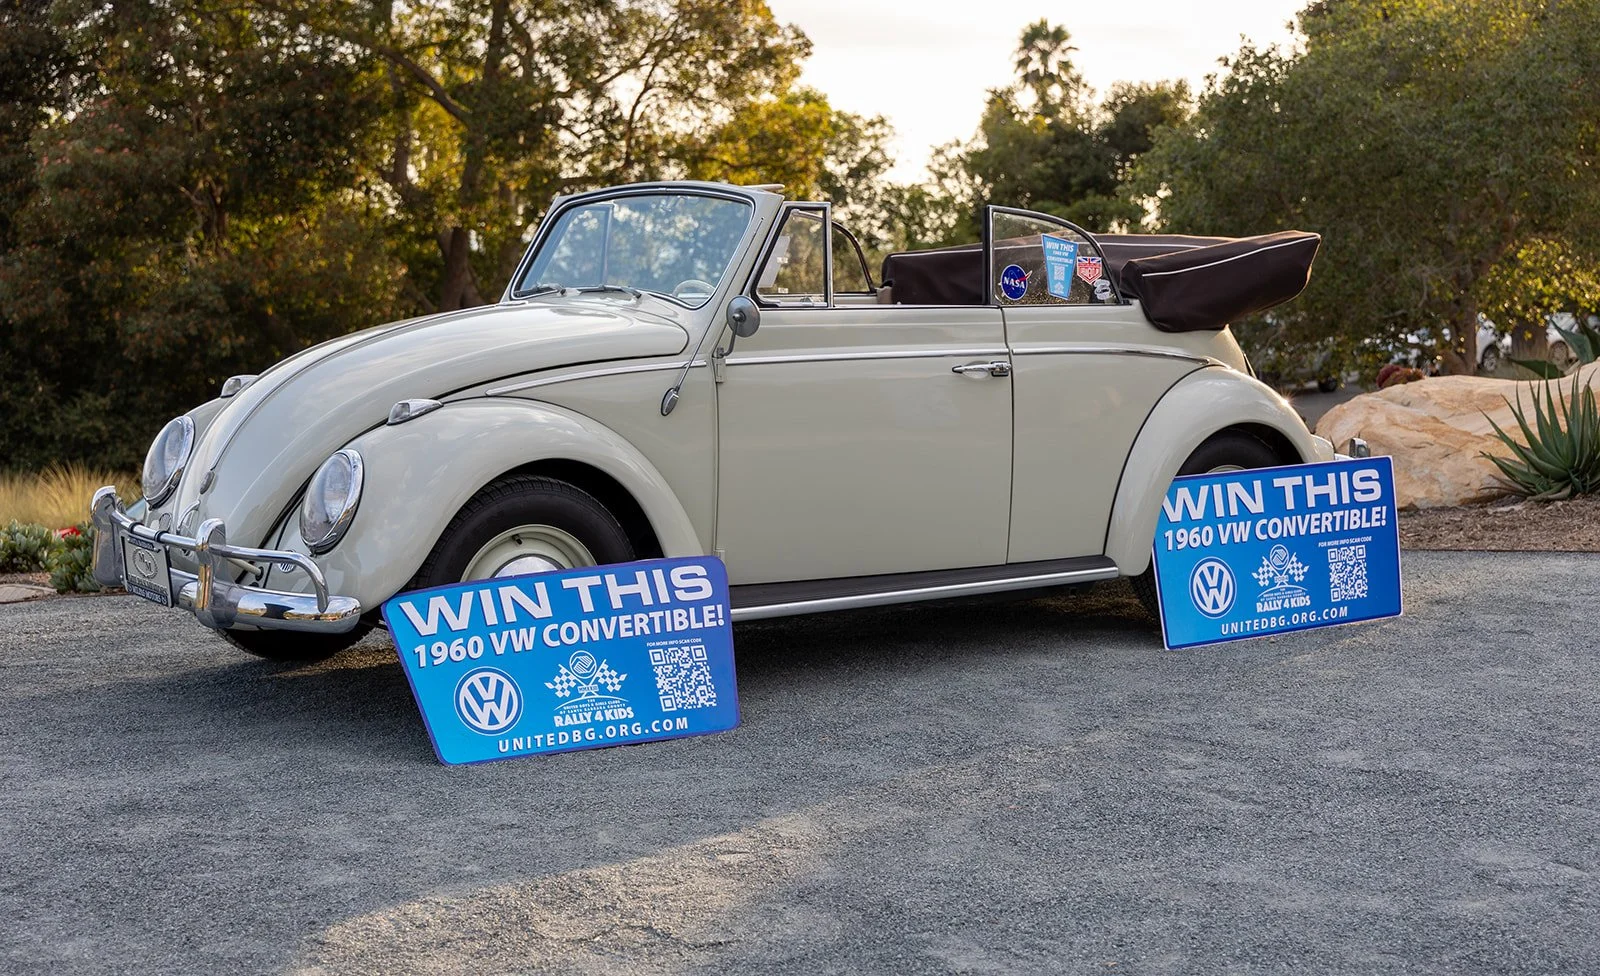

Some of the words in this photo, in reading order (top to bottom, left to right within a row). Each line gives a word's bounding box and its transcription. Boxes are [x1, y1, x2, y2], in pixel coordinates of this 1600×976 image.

[1046, 241, 1059, 250] WIN
[1060, 243, 1074, 253] THIS
[1003, 276, 1026, 289] NASA
[1161, 480, 1265, 523] WIN
[1272, 468, 1382, 510] THIS
[1164, 525, 1213, 551] 1960
[1217, 520, 1252, 545] VW
[1255, 506, 1388, 541] CONVERTIBLE!
[399, 580, 553, 637] WIN
[561, 565, 714, 613] THIS
[1192, 560, 1234, 615] VW
[1256, 599, 1283, 613] RALLY
[1283, 598, 1290, 609] 4
[1290, 595, 1311, 608] KIDS
[414, 635, 484, 668] 1960
[490, 626, 537, 655] VW
[543, 605, 725, 647] CONVERTIBLE!
[1221, 606, 1348, 635] UNITEDBG.ORG.COM
[456, 670, 520, 733] VW
[553, 711, 592, 727] RALLY
[594, 710, 604, 721] 4
[604, 706, 634, 720] KIDS
[498, 716, 689, 753] UNITEDBG.ORG.COM
